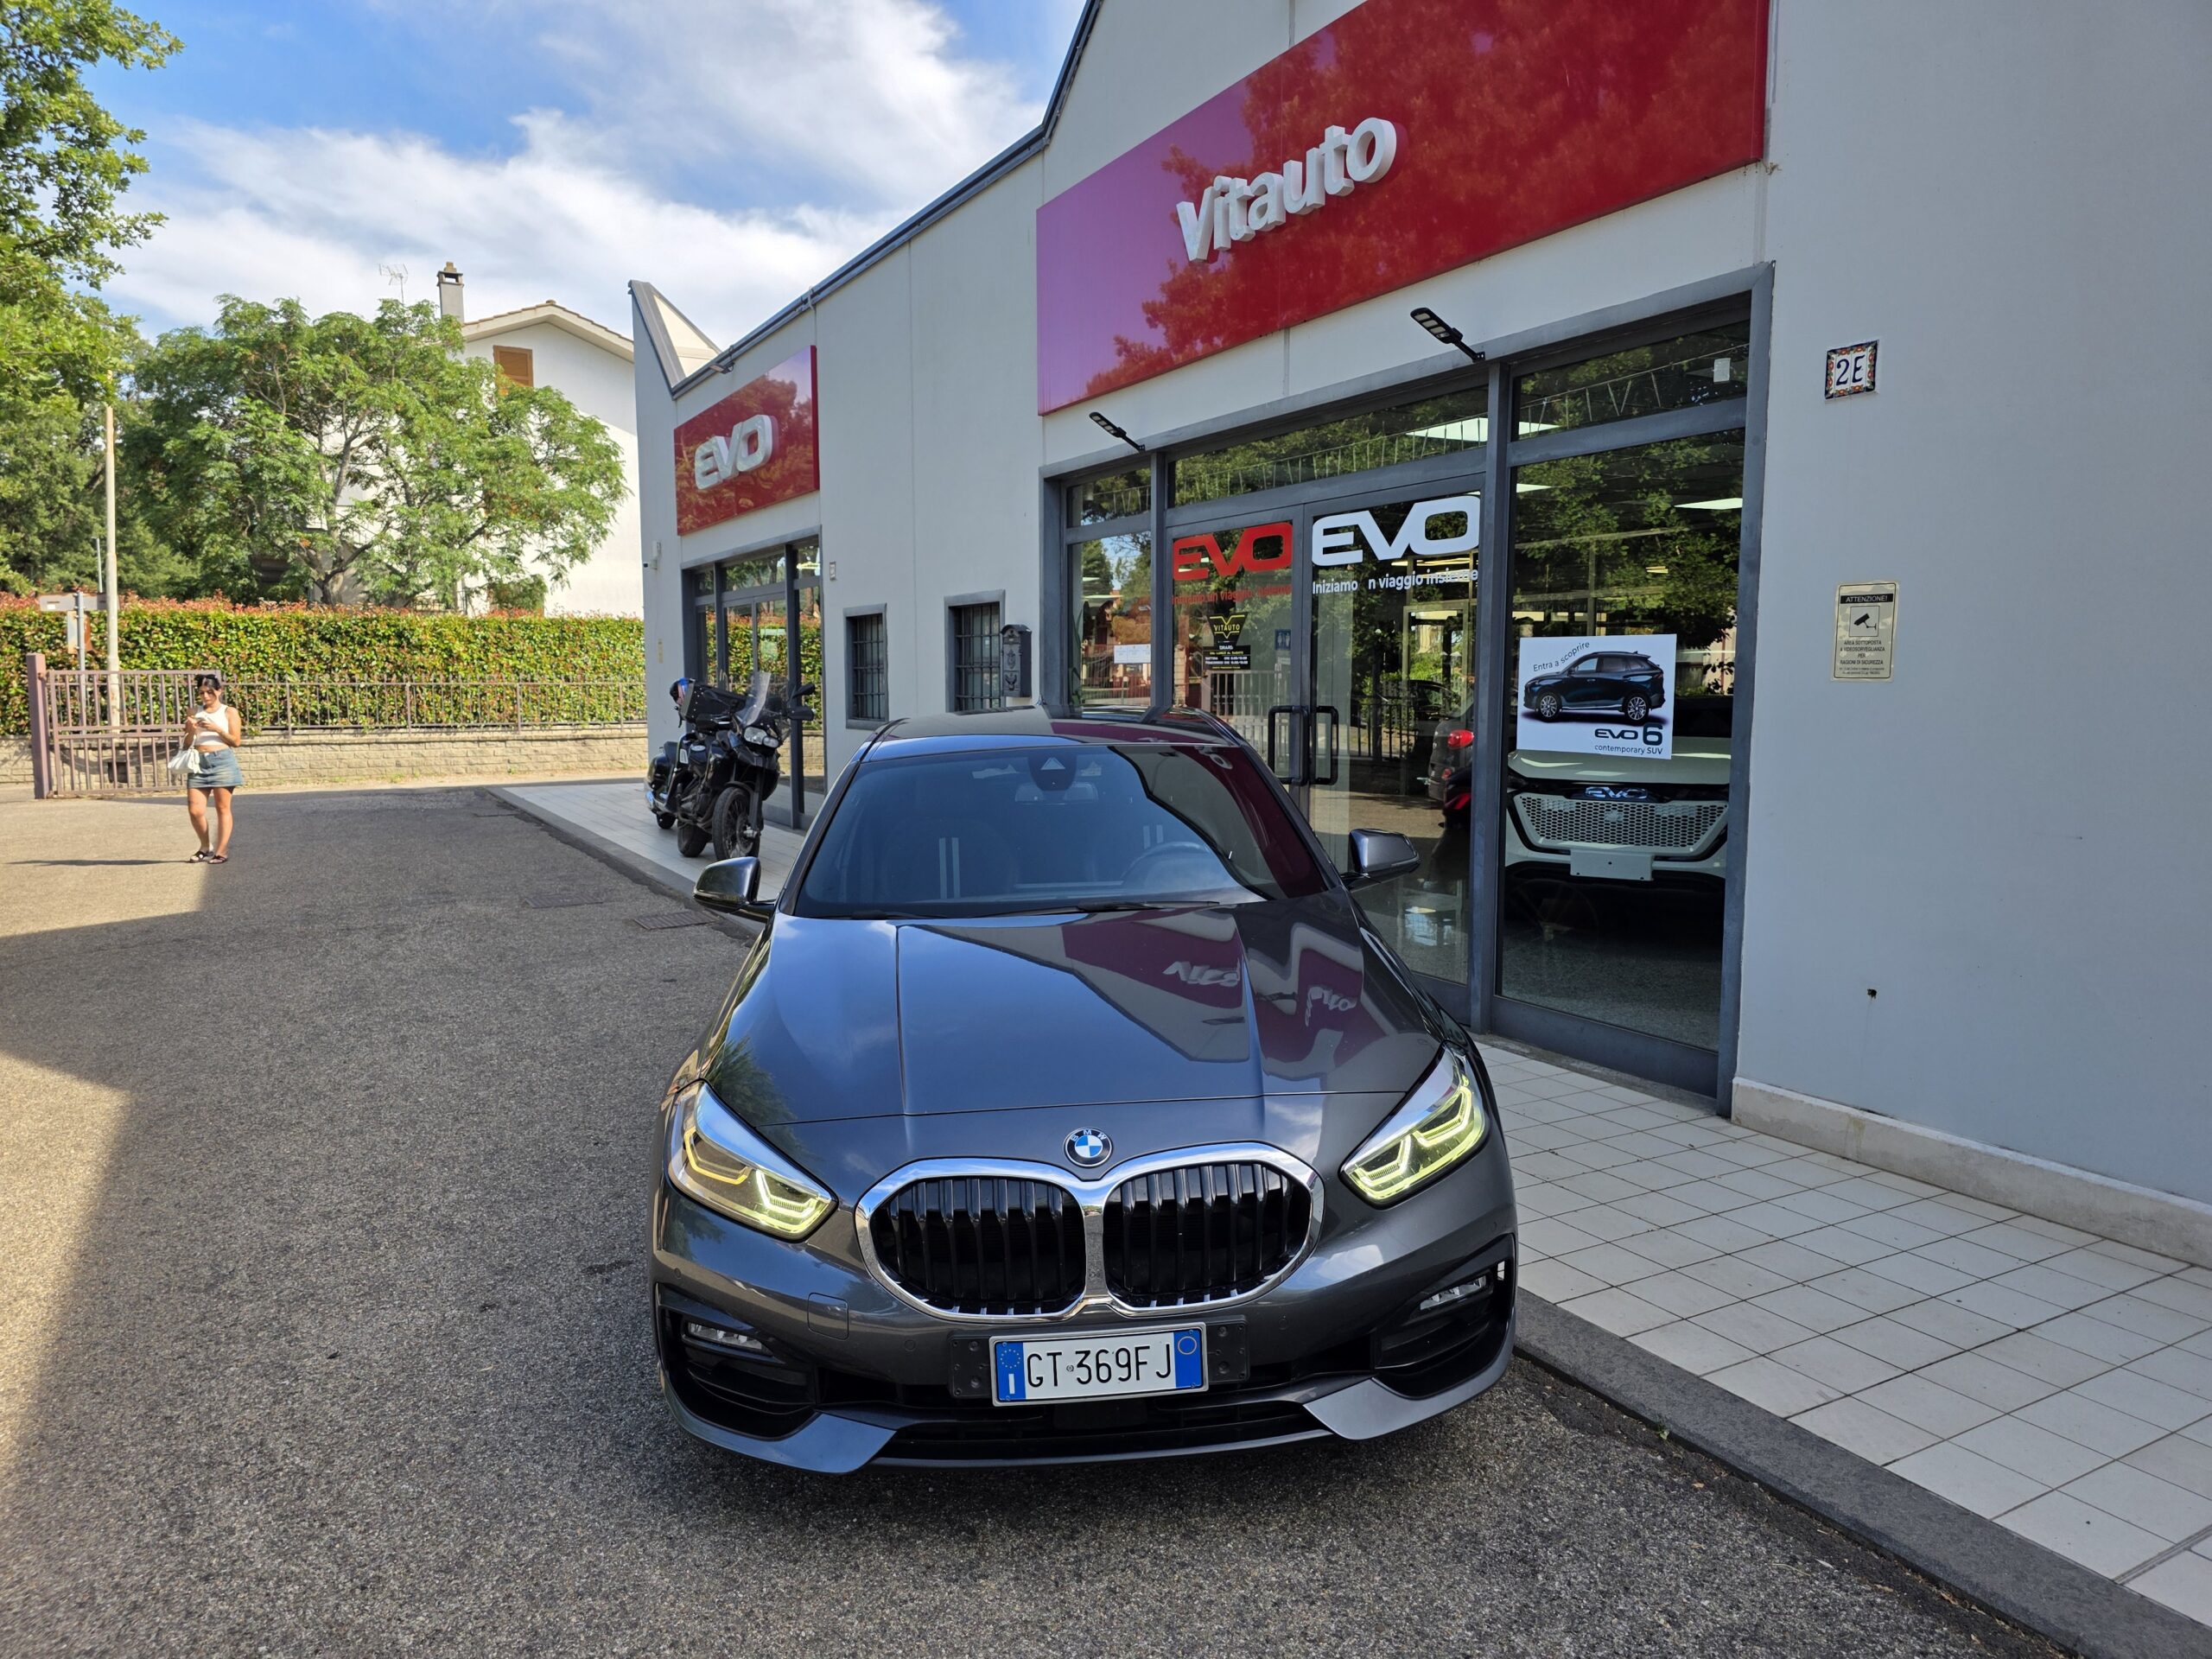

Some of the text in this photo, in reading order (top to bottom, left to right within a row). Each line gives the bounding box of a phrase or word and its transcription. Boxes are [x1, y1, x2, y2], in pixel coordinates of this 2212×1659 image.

[1176, 118, 1396, 261] Vitauto
[1836, 355, 1866, 386] 2E
[695, 415, 772, 490] EVO
[1312, 495, 1480, 566] EVO
[1173, 522, 1293, 581] EVO
[1313, 578, 1358, 594] Iniziamo
[1378, 570, 1423, 591] viaggio
[1845, 594, 1888, 603] ATTENZIONE!
[1533, 662, 1554, 672] Entra
[1560, 641, 1590, 664] scoprire
[1594, 723, 1663, 746] EVO 6
[1594, 744, 1644, 755] contemporary
[1585, 785, 1649, 799] EVO
[1070, 1128, 1107, 1141] BMW
